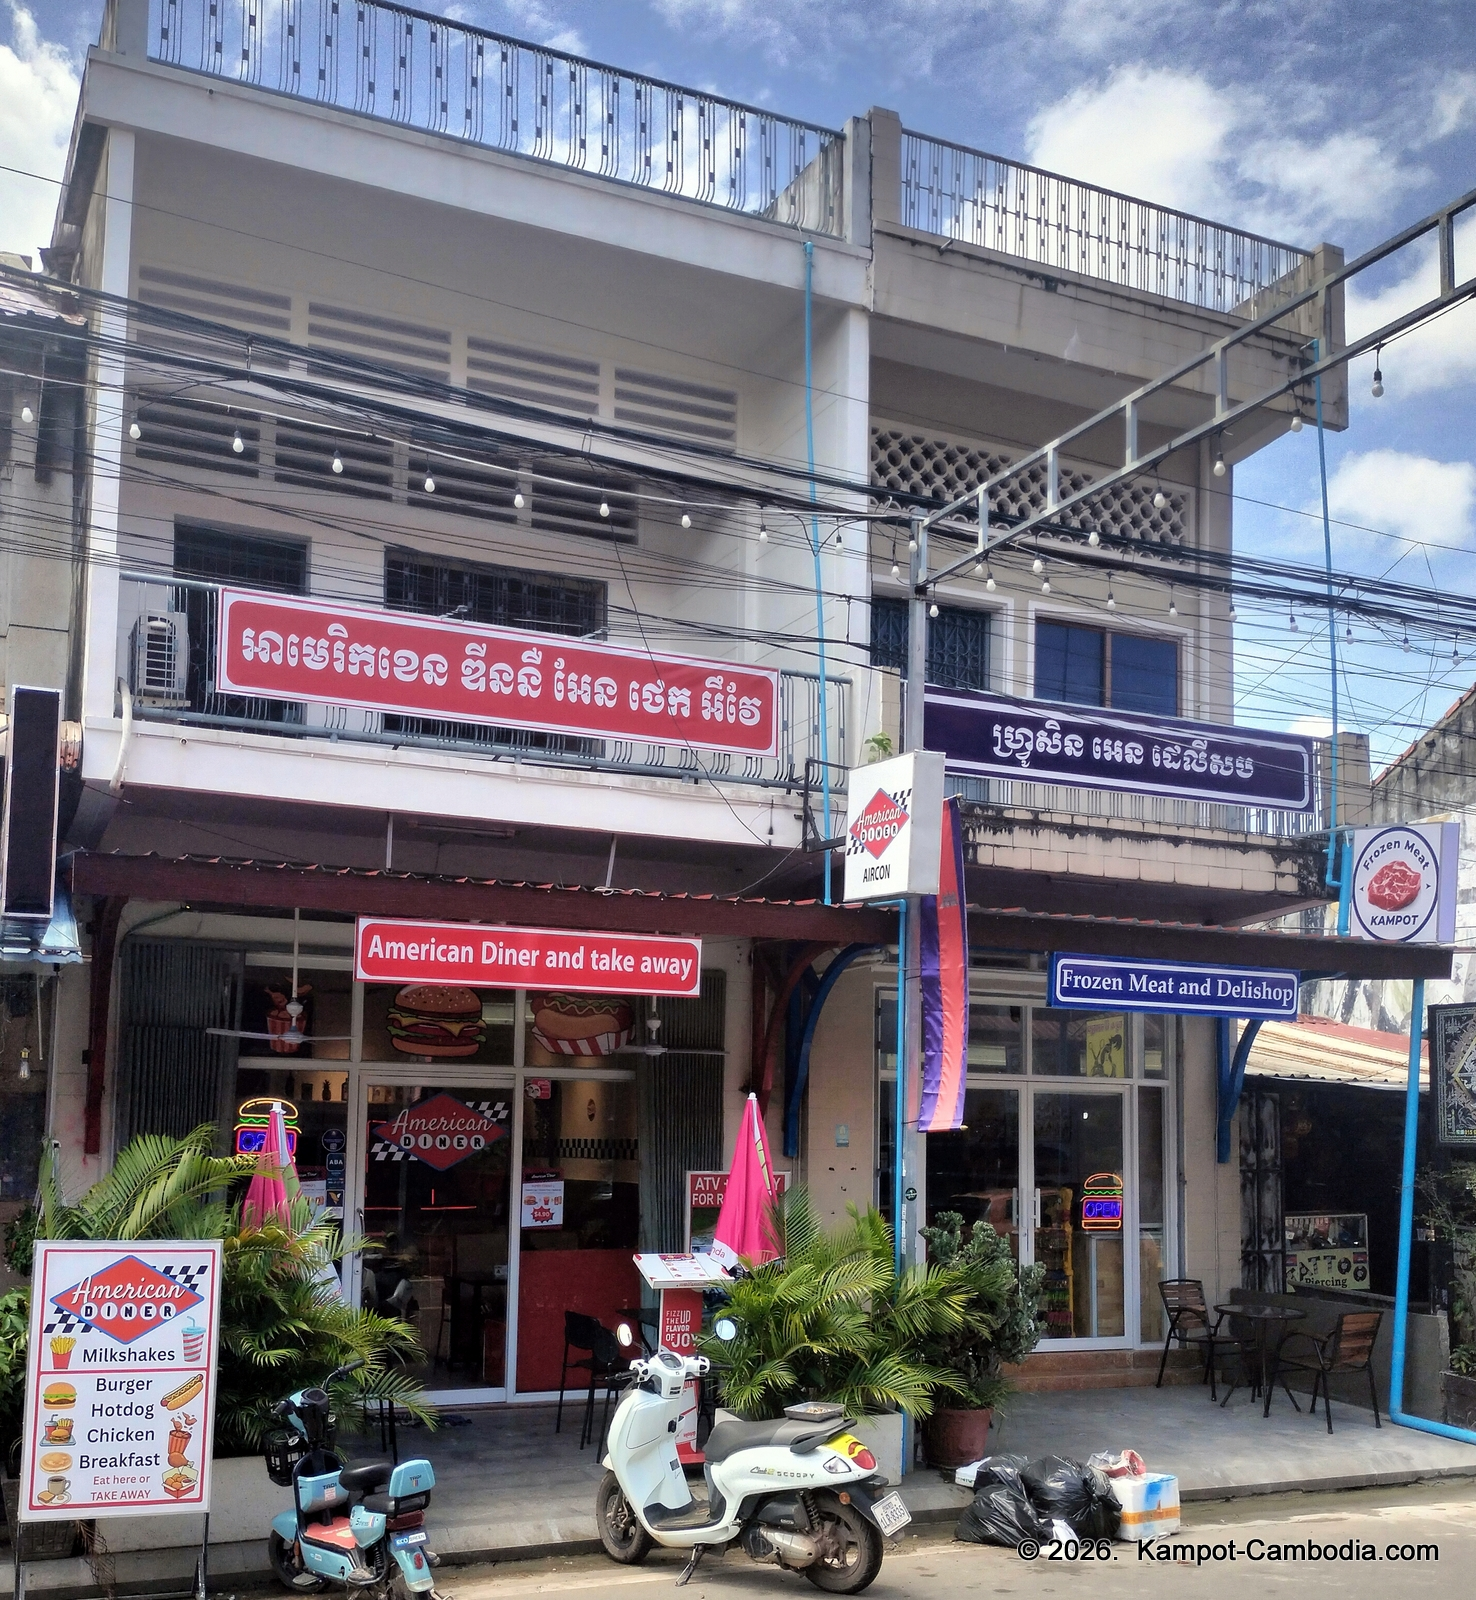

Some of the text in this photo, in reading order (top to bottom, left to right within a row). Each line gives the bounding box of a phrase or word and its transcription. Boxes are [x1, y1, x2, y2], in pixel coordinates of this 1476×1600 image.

[554, 658, 617, 708] អែន
[1091, 737, 1144, 765] អេន
[856, 804, 901, 832] American
[861, 824, 898, 842] DINER
[1363, 840, 1430, 871] Frozen Meat
[863, 864, 890, 883] AIRCON
[1370, 915, 1419, 926] KAMPOT
[367, 935, 693, 981] American Diner and take away
[1061, 969, 1294, 1006] Frozen Meat and Delishop
[392, 1109, 492, 1134] American
[403, 1136, 483, 1148] DINER
[695, 1177, 720, 1190] ATV
[692, 1193, 714, 1205] FOR
[1085, 1202, 1120, 1217] OPEN
[71, 1276, 185, 1305] American
[83, 1305, 174, 1318] DINER
[680, 1310, 691, 1324] UP
[666, 1317, 680, 1325] THE
[665, 1333, 675, 1341] OF
[83, 1348, 175, 1363] Milkshakes
[96, 1378, 153, 1394] Burger
[91, 1403, 154, 1419] Hotdog
[87, 1428, 155, 1443] Chicken
[79, 1452, 160, 1469] Breakfast
[93, 1474, 150, 1486] Eat here or
[91, 1489, 151, 1501] TAKE AWAY
